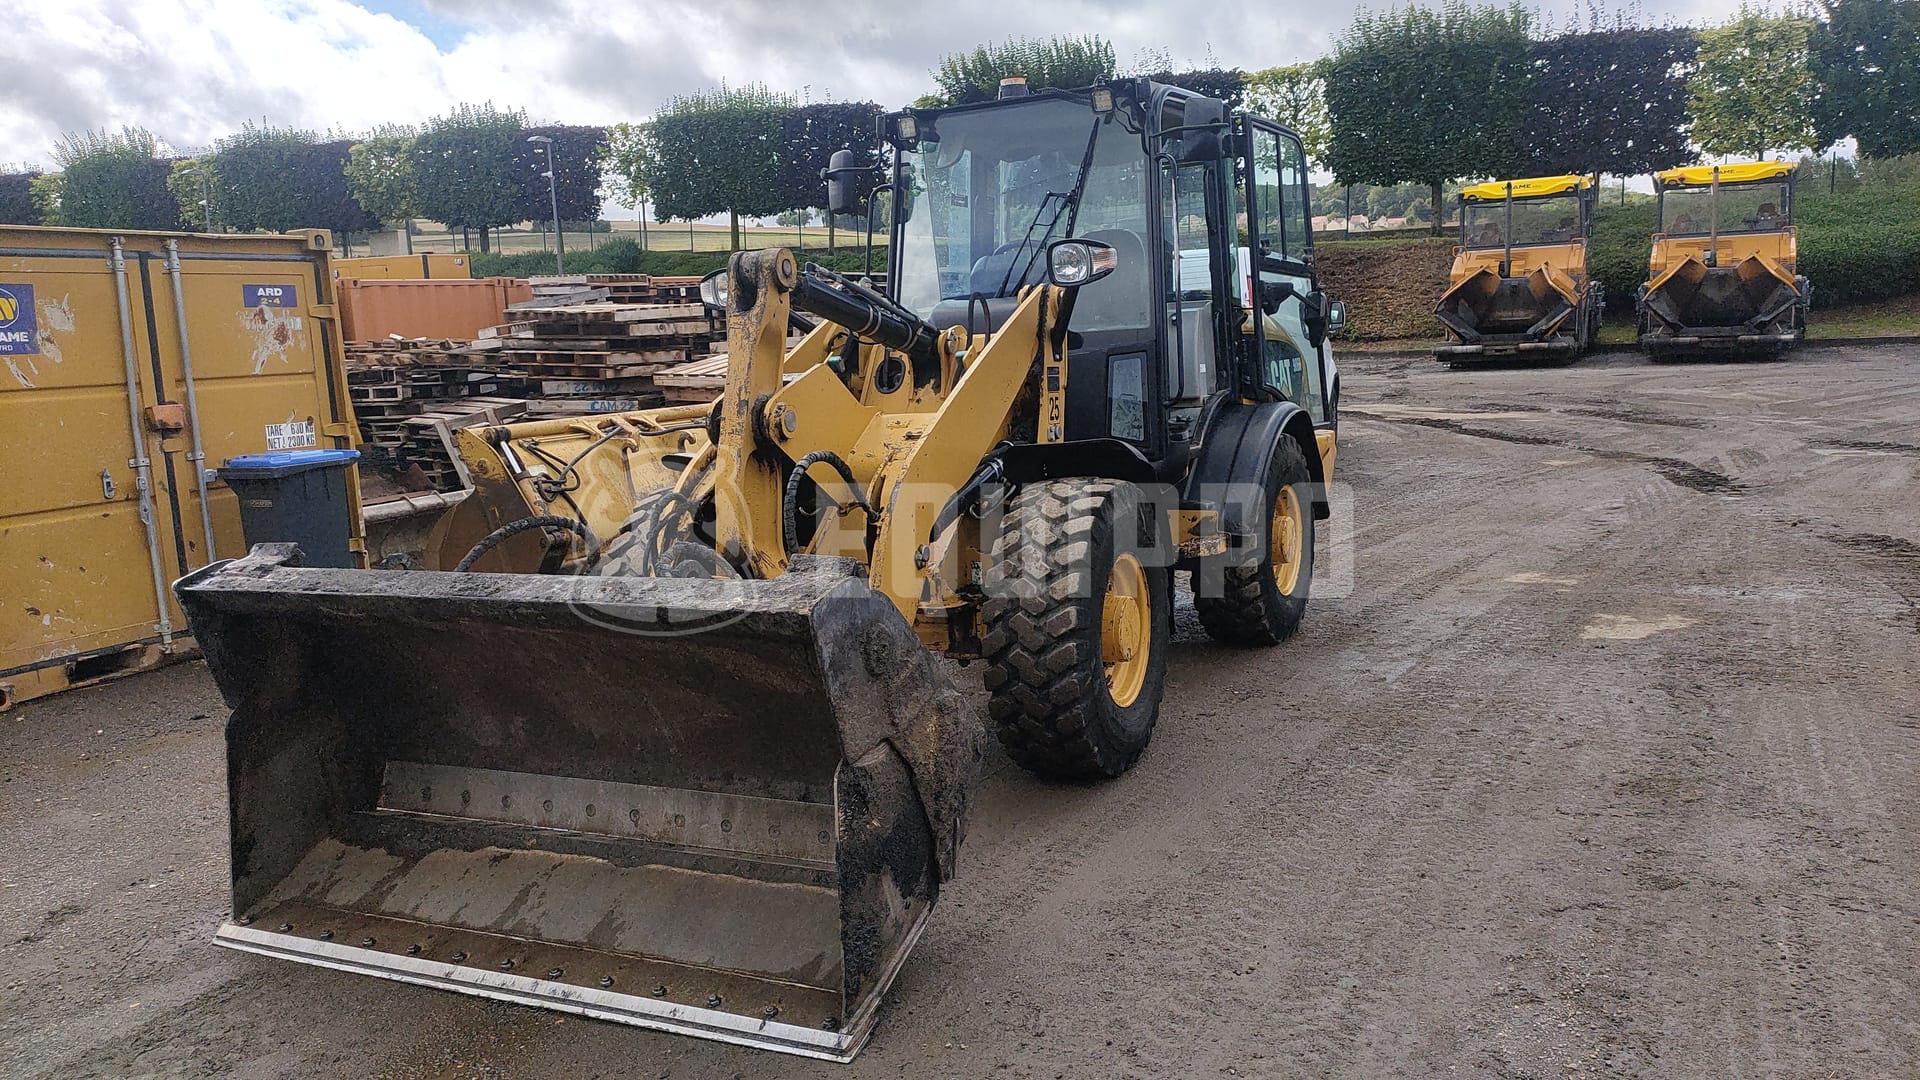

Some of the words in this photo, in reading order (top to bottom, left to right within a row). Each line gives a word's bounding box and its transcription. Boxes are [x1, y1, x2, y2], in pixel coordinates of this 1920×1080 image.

[257, 287, 283, 297] ARD
[261, 297, 281, 305] 2-4
[1270, 358, 1293, 396] CAT
[620, 401, 636, 411] 22
[1049, 396, 1060, 421] 25
[267, 425, 283, 436] TARE
[290, 423, 303, 434] 630
[305, 422, 313, 433] KG
[268, 438, 280, 449] NET
[288, 436, 305, 447] 2300
[306, 434, 315, 445] KG
